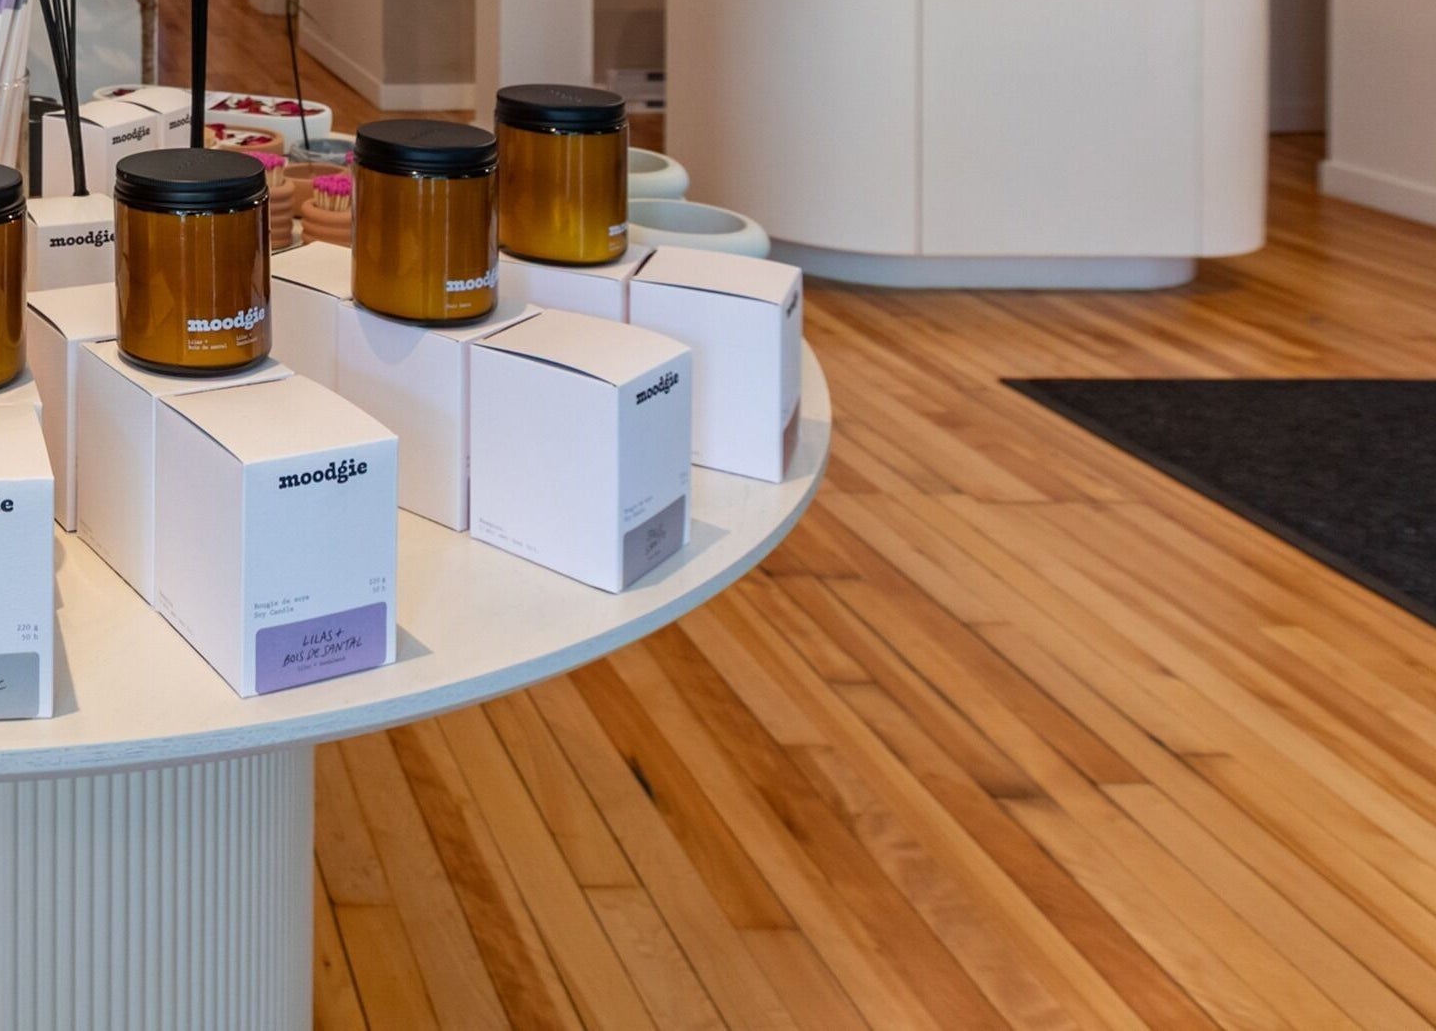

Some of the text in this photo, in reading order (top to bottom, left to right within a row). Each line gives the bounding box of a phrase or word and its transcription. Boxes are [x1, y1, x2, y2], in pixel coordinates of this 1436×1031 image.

[169, 114, 191, 130] mood
[112, 127, 151, 145] moodgie
[187, 306, 265, 332] moodgie
[636, 371, 679, 405] moodgie
[278, 458, 368, 489] moodgie
[302, 630, 333, 647] LILAS
